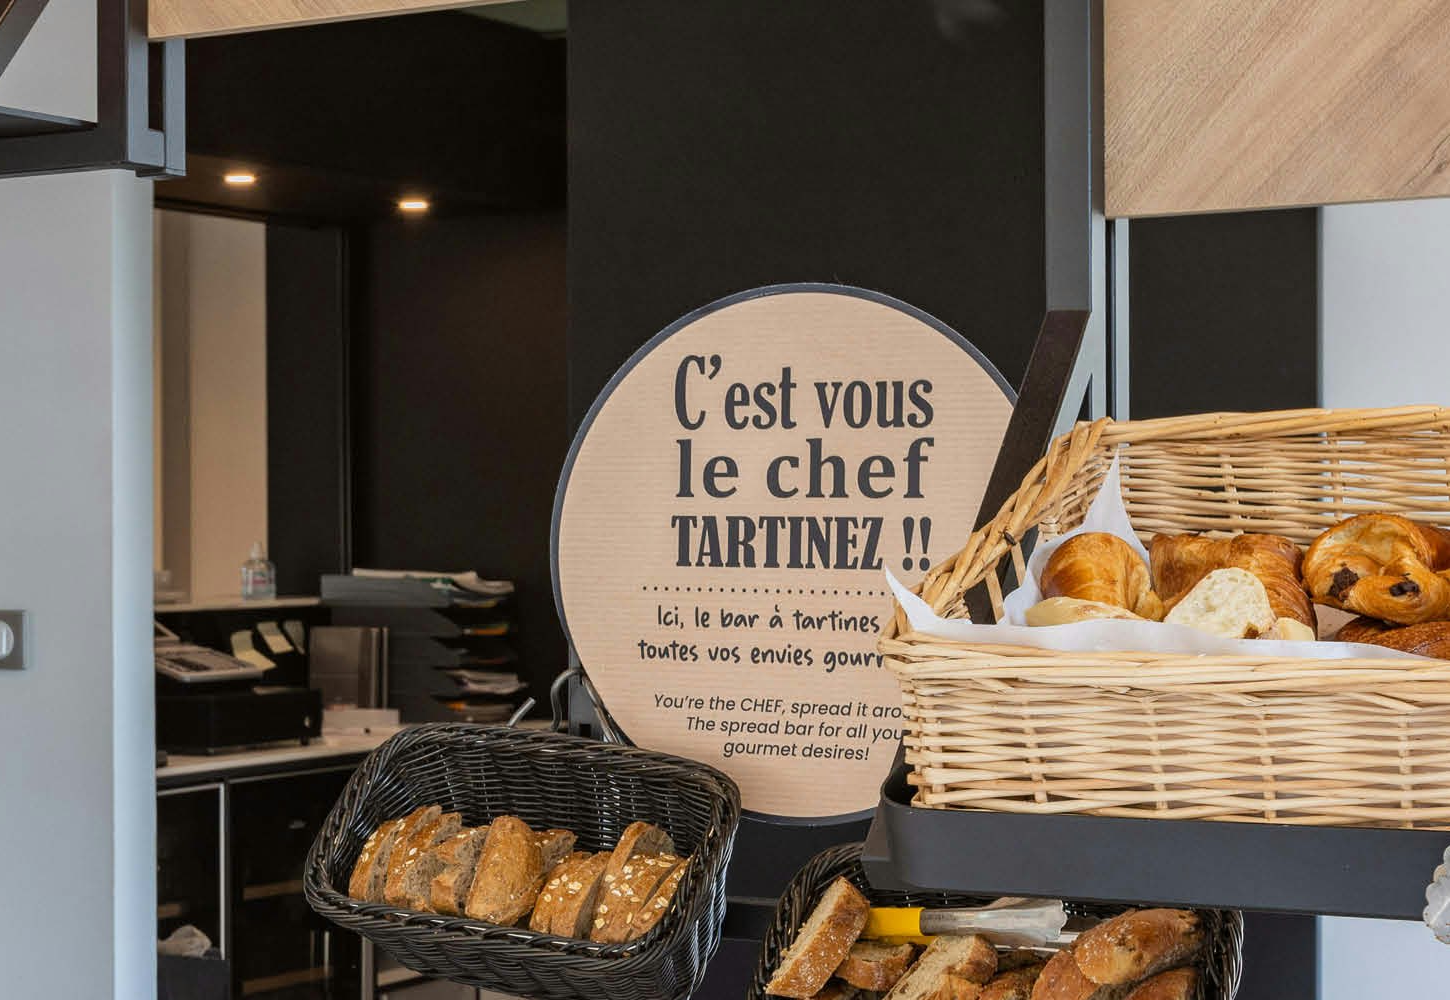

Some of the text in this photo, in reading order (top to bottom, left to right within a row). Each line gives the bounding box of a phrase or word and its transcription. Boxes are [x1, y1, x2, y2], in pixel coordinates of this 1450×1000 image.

[813, 378, 935, 430] vous
[674, 437, 936, 500] le chef
[671, 515, 885, 571] TARTINEZ
[656, 603, 881, 634] Ici, le bar à tartines
[637, 639, 699, 662] toutes
[707, 645, 742, 664] vos
[749, 647, 814, 666] envies
[708, 695, 737, 712] the
[739, 697, 787, 716] CHEF,
[790, 701, 852, 719] spread
[856, 702, 868, 718] it
[686, 716, 716, 732] The
[719, 718, 780, 738] spread
[784, 721, 814, 737] bar
[817, 722, 843, 738] for
[845, 725, 868, 740] all
[722, 739, 870, 761] gourmet desires!
